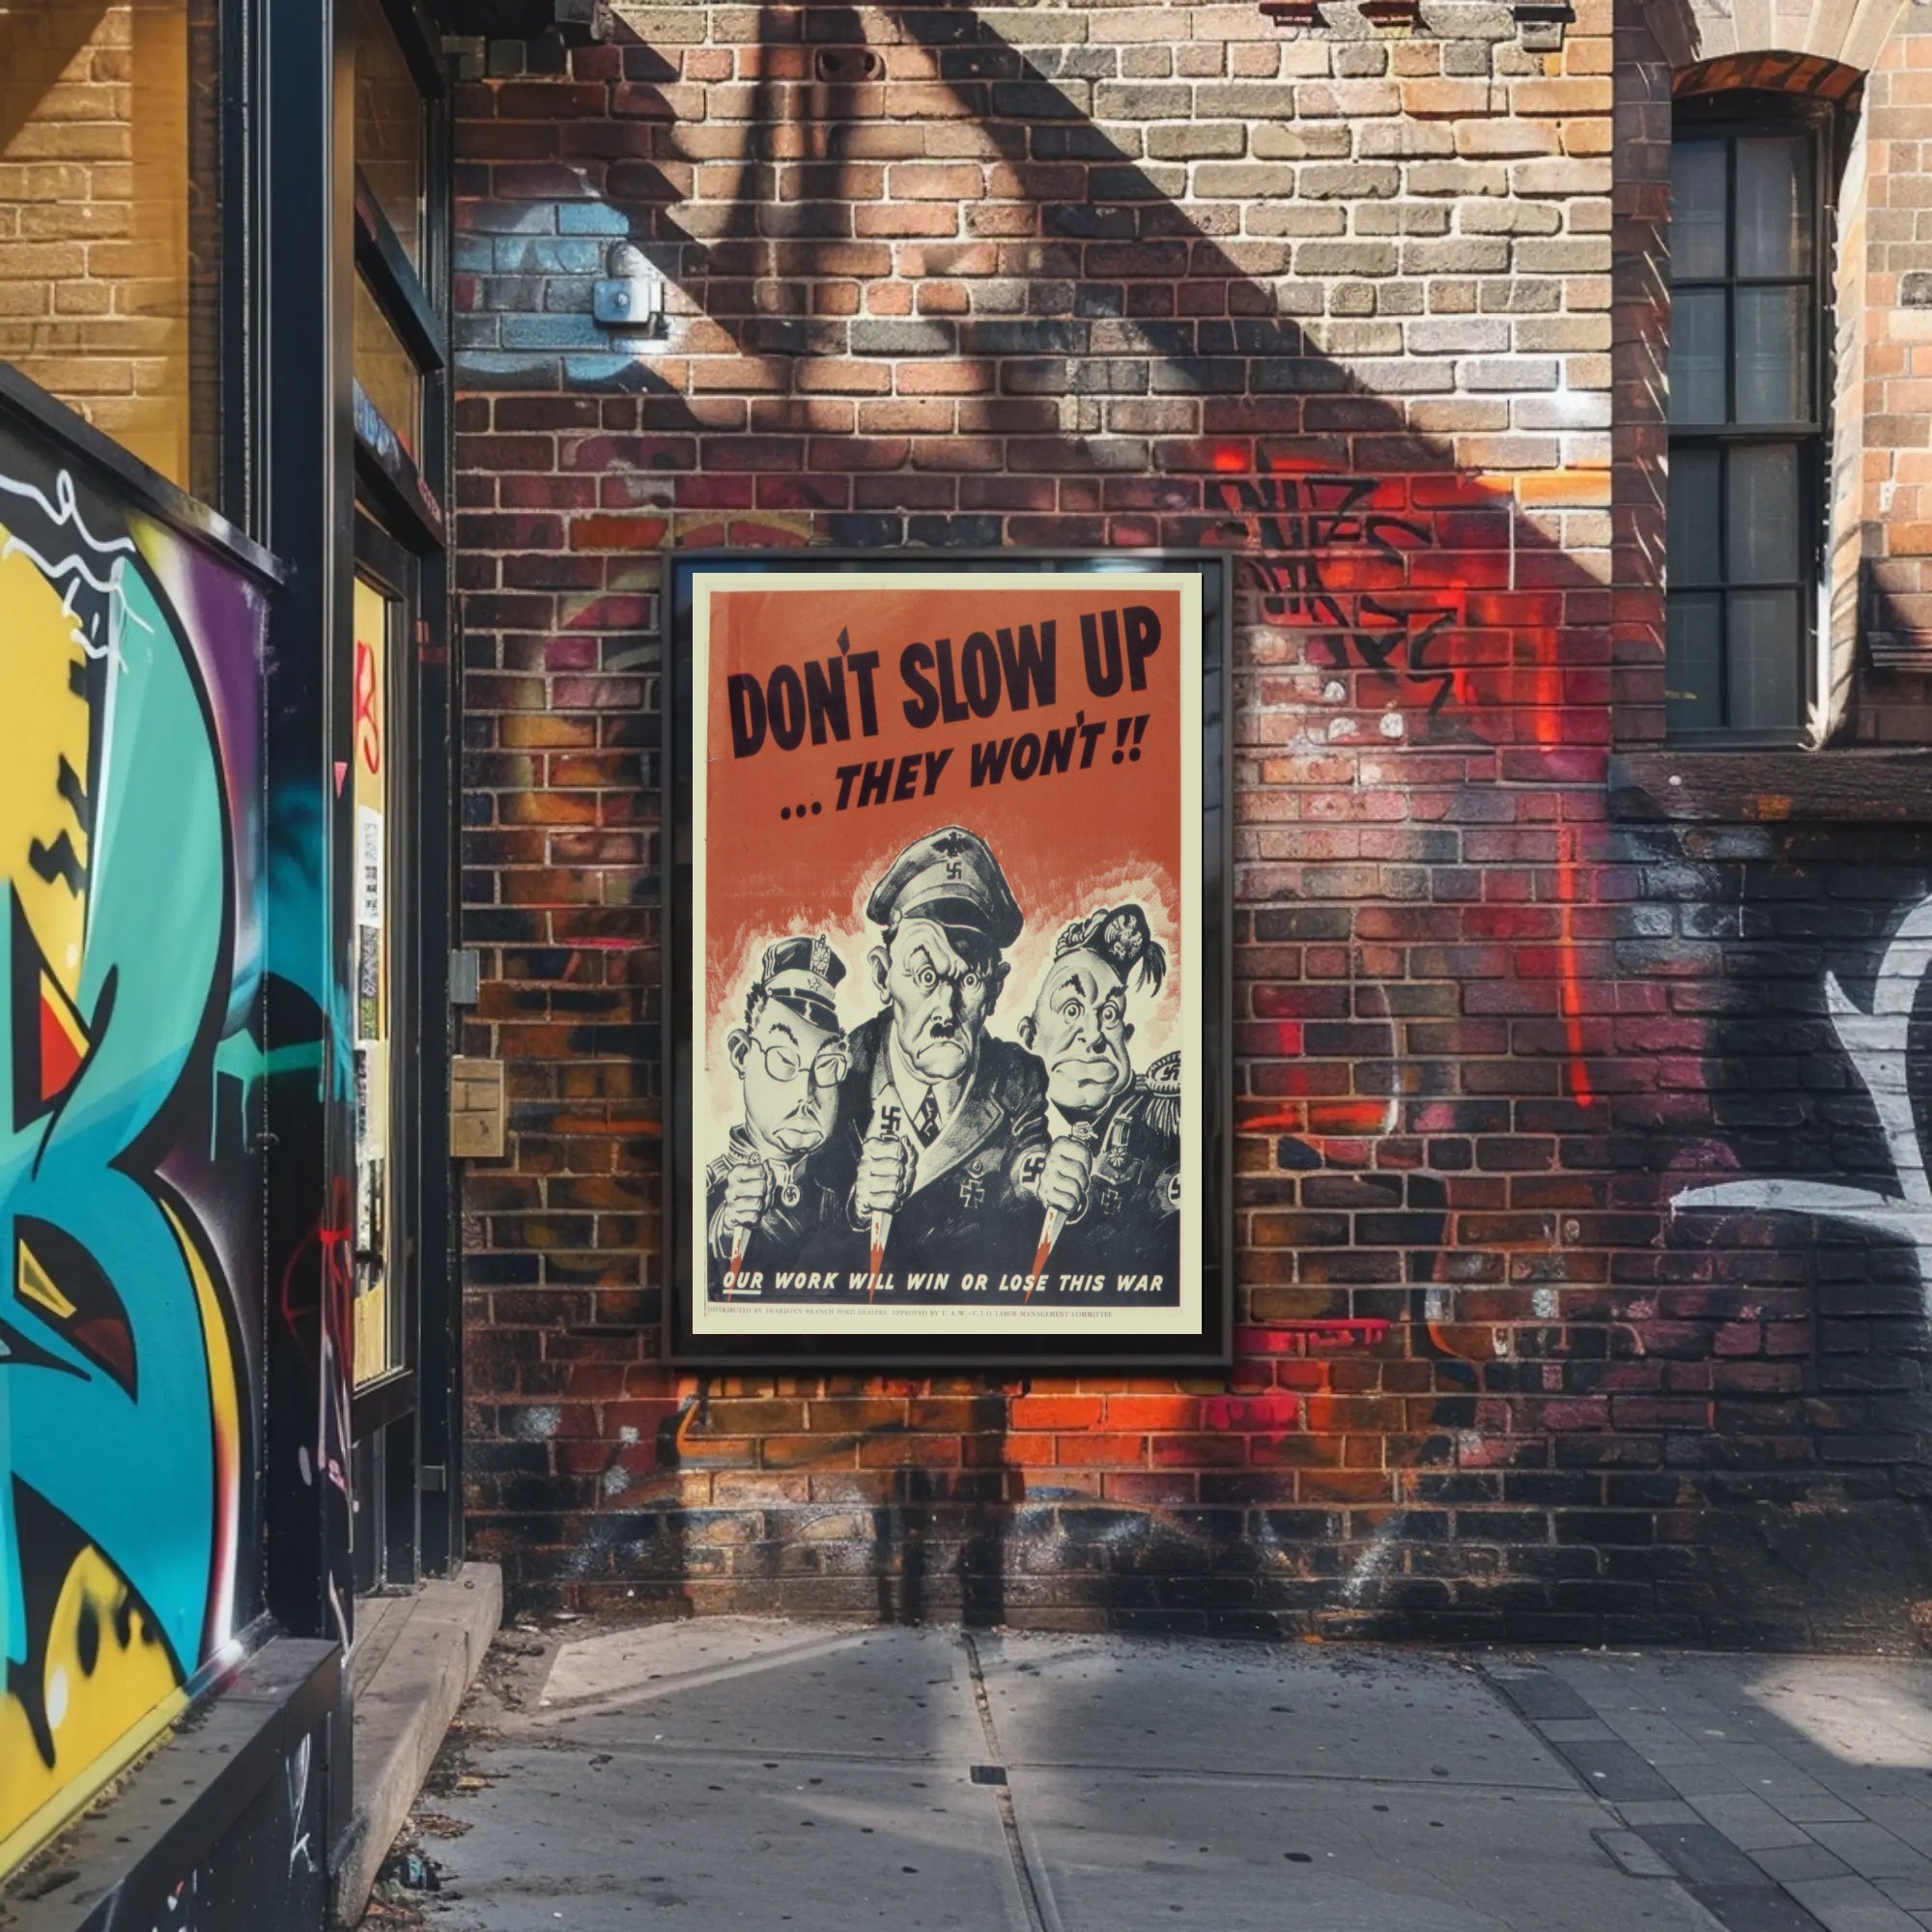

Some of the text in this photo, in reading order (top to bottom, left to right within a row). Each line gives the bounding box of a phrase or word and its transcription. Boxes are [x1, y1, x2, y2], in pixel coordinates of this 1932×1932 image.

[726, 605, 1161, 758] DON'T SLOW UP
[723, 1271, 1164, 1293] OUR WORK WILL WIN OR LOSE THIS WAR
[707, 1306, 752, 1315] DISTRIBUTED
